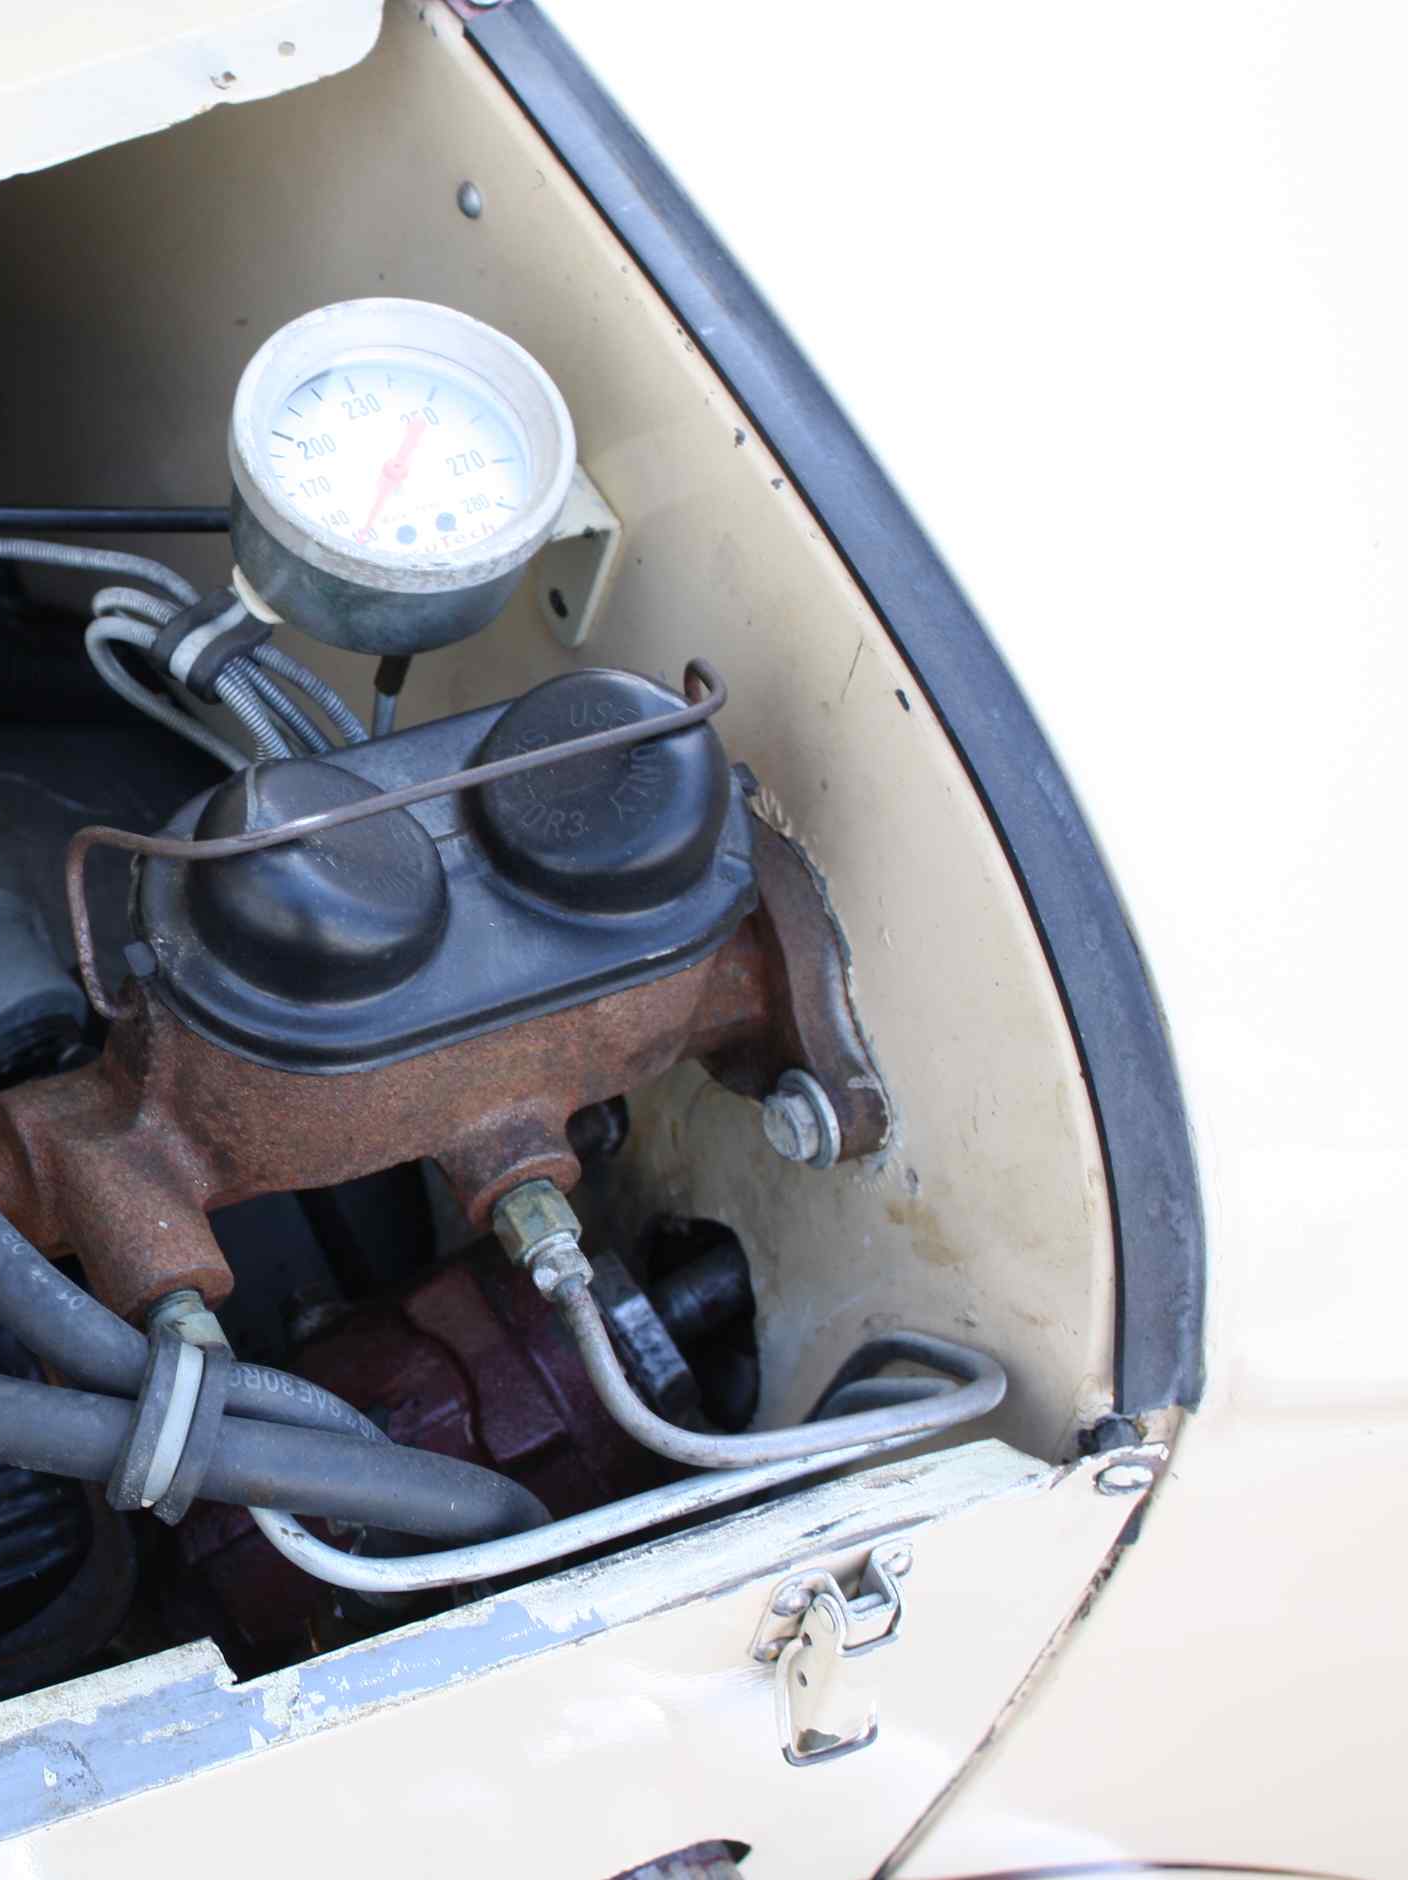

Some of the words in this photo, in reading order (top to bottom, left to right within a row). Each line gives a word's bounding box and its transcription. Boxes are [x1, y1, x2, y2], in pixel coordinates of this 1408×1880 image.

[341, 392, 383, 421] 230
[296, 433, 337, 461] 200
[445, 449, 486, 478] 270
[298, 475, 332, 501] 170
